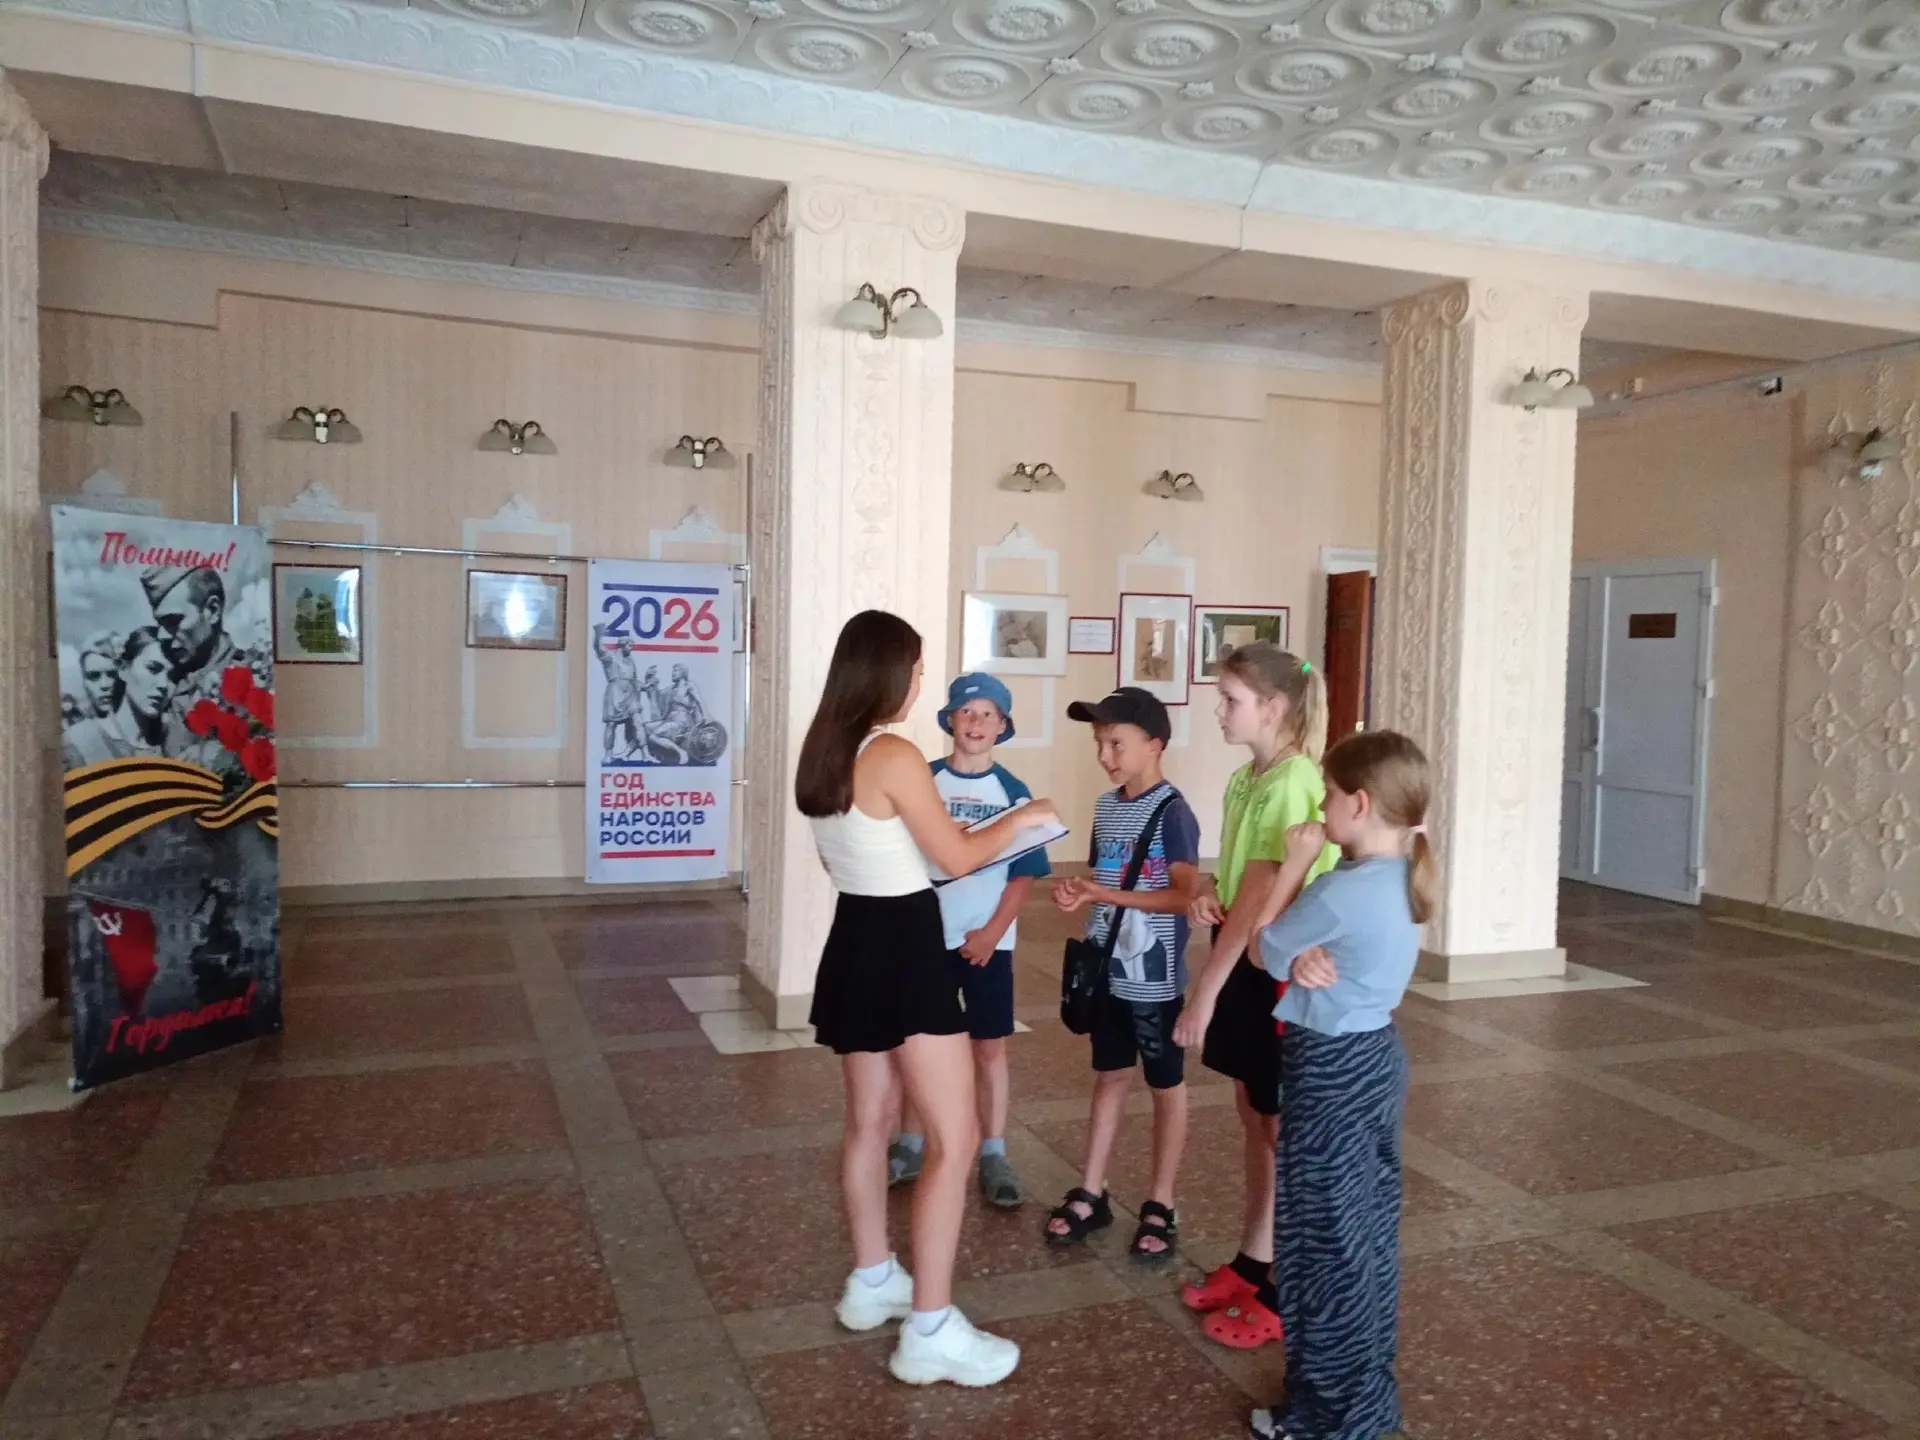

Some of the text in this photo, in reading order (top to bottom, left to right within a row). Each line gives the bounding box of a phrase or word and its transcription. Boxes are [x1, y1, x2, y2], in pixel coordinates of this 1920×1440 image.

[100, 531, 237, 572] Помним!
[602, 594, 720, 641] 2026
[600, 772, 645, 790] ГОД
[600, 791, 717, 810] ЕДИНСТВА
[600, 810, 706, 828] НАРОДОВ
[600, 829, 692, 846] РОССИИ
